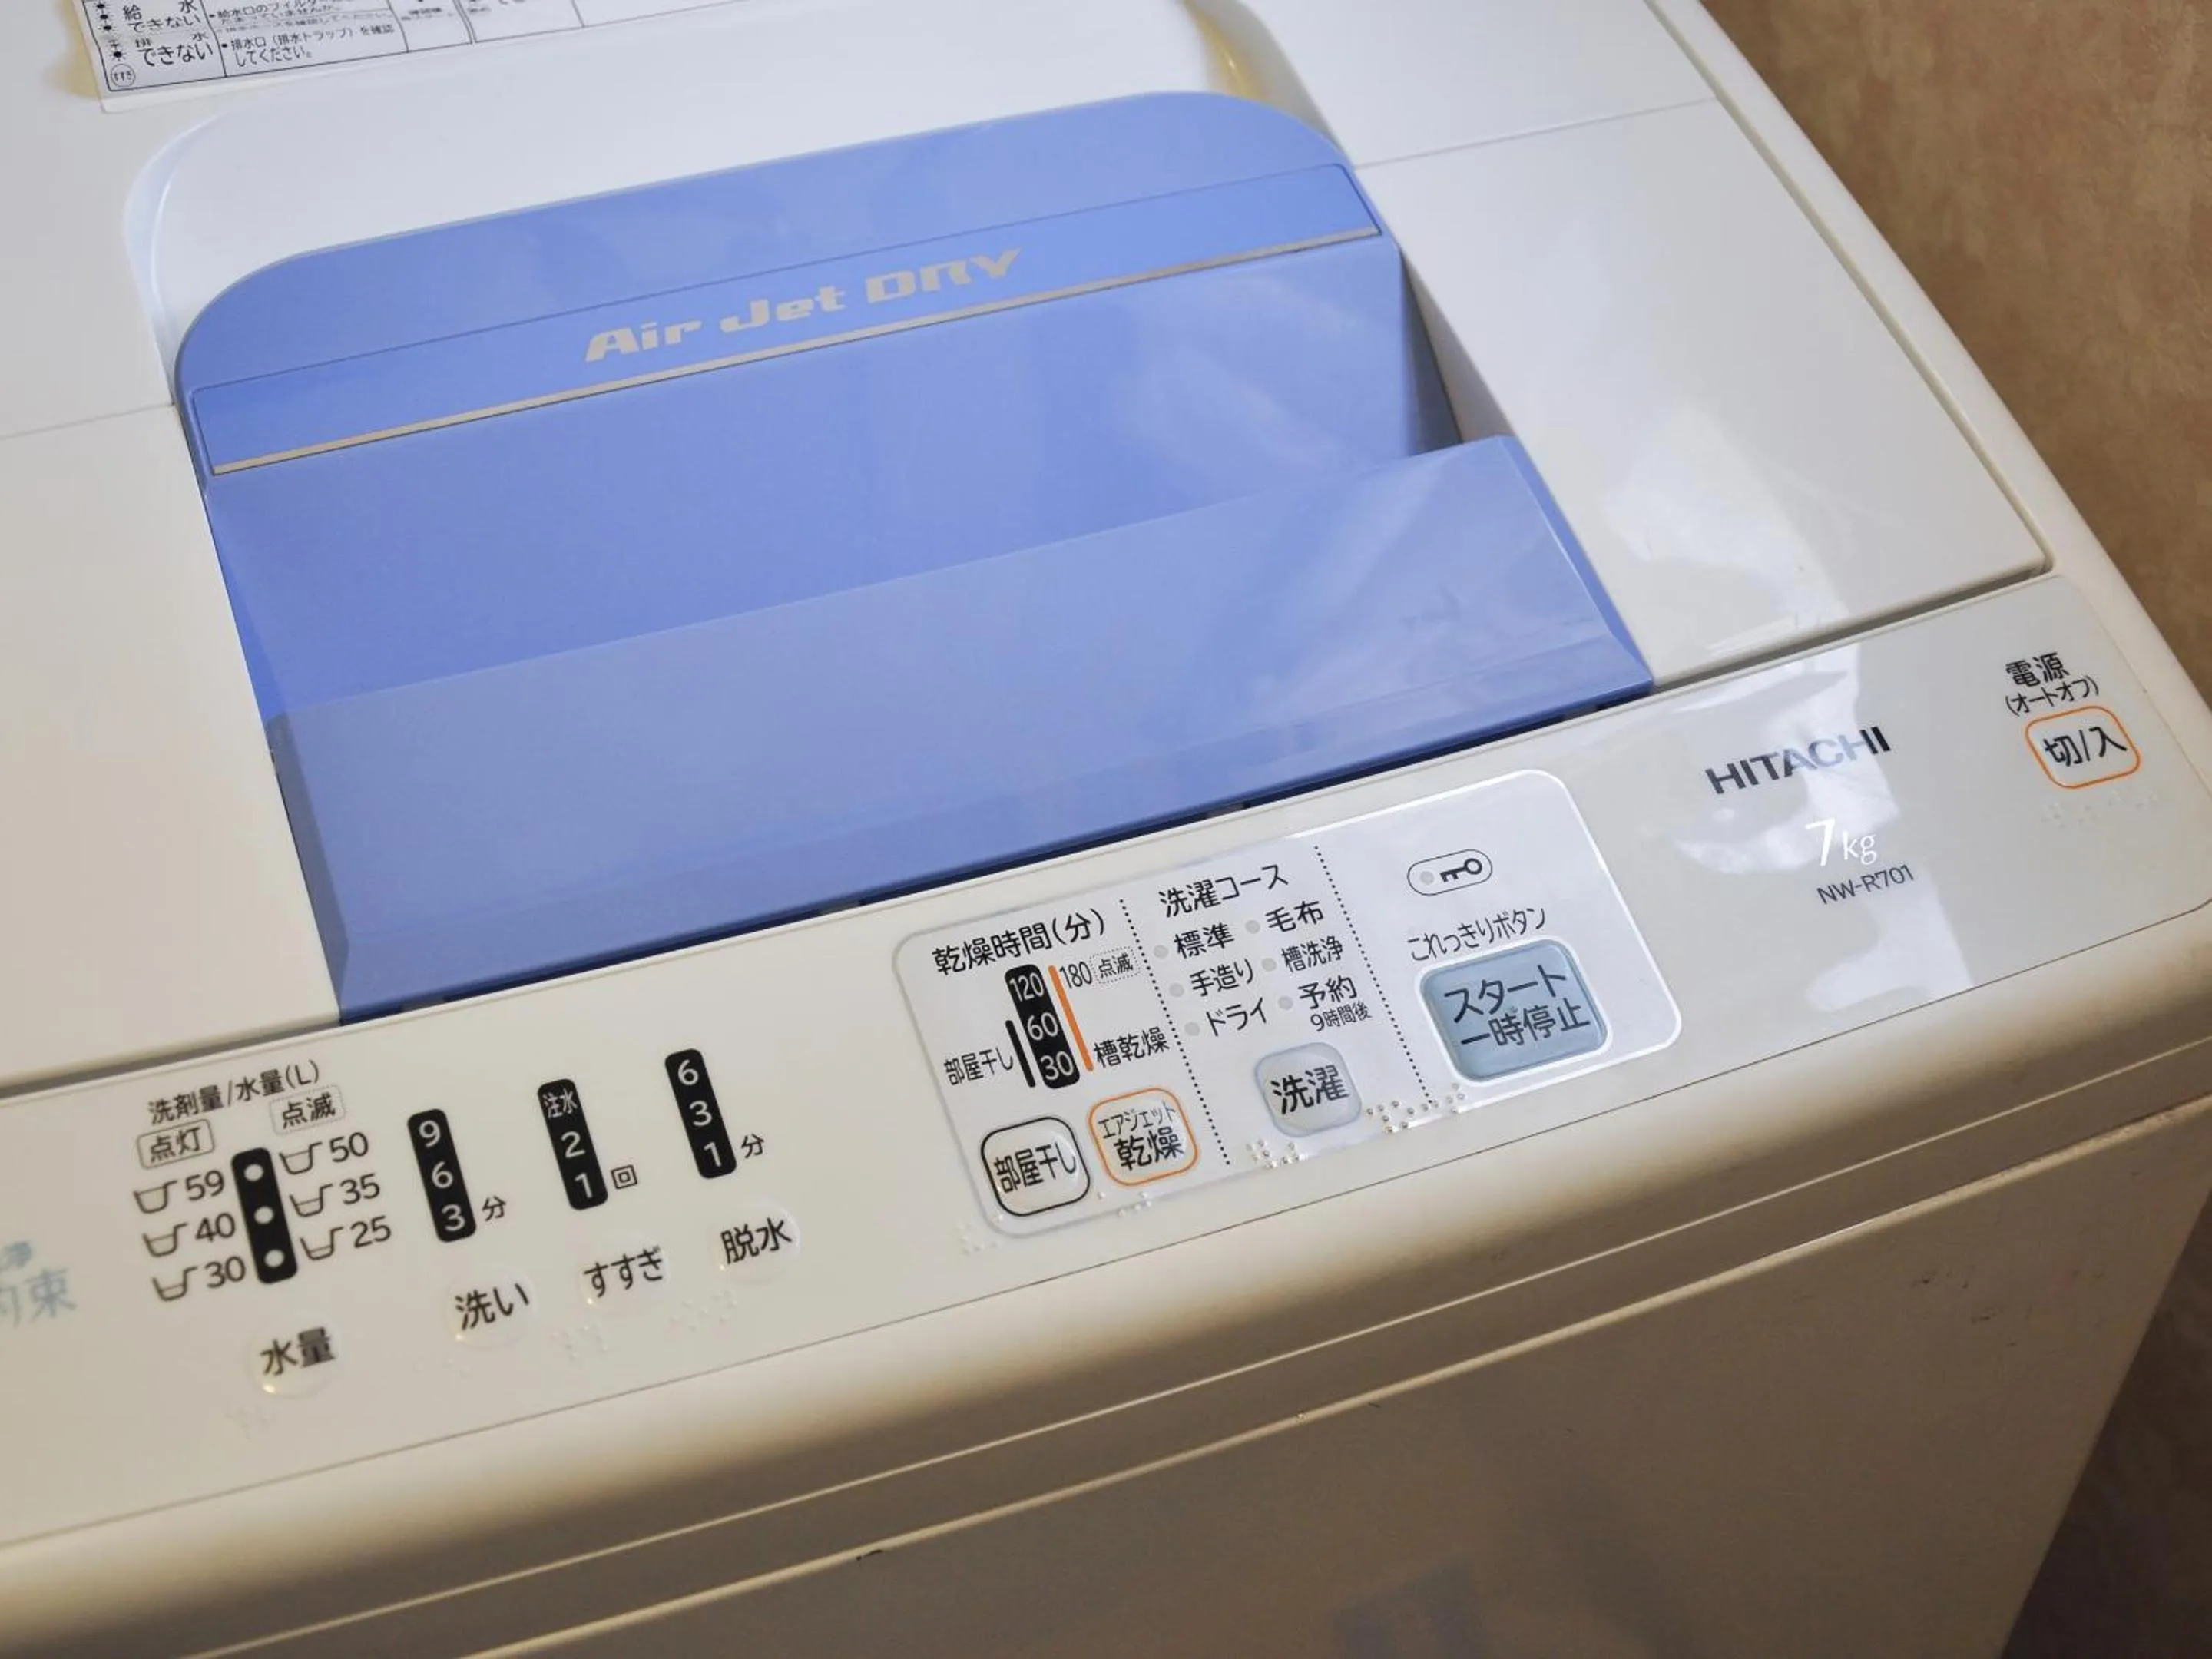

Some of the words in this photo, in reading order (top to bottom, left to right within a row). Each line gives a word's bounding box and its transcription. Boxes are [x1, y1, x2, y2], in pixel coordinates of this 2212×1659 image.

[137, 43, 214, 67] できない
[584, 320, 702, 362] Air
[720, 285, 846, 333] Jet
[865, 248, 1022, 304] DRY
[2005, 652, 2070, 687] 電源
[2005, 675, 2099, 717] (オートオフ)
[1705, 726, 1892, 795] HITACHI
[2043, 726, 2128, 767] 切/入
[1158, 864, 1289, 918] 洗濯コース
[1816, 864, 1915, 905] NW-R701
[1265, 900, 1325, 933] 毛布
[1407, 907, 1545, 961] これっきりボタン
[932, 908, 1105, 975] 乾燥時間(分)
[1174, 922, 1235, 959] 標準
[1281, 935, 1344, 973] 槽洗浄
[1009, 972, 1045, 1002] 120
[1059, 960, 1093, 989] 180
[1098, 953, 1133, 979] 点滅
[1190, 959, 1255, 998] 手造り
[1298, 975, 1358, 1010] 予約
[1444, 965, 1567, 1024] スタート
[1027, 1012, 1058, 1041] 60
[1206, 997, 1267, 1037] ドライ
[1310, 1001, 1373, 1031] 9時間後
[1460, 998, 1591, 1046] 一時停止
[944, 1046, 1015, 1086] 部屋干し
[1039, 1050, 1074, 1081] 30
[1094, 1027, 1171, 1069] 槽乾燥
[677, 1058, 699, 1087] 6
[1270, 1065, 1349, 1115] 洗濯
[281, 1092, 337, 1129] 点滅
[542, 1088, 578, 1118] 注水
[688, 1100, 713, 1127] 3
[1098, 1101, 1177, 1140] エアジェット
[149, 1127, 202, 1162] 点灯
[329, 1131, 369, 1163] 50
[419, 1120, 441, 1148] 9
[561, 1131, 586, 1158] 2
[704, 1141, 723, 1167] 1
[741, 1133, 765, 1159] 分
[1114, 1127, 1184, 1171] 乾燥
[184, 1170, 225, 1202] 59
[431, 1162, 454, 1190] 6
[574, 1172, 593, 1198] 1
[611, 1164, 637, 1189] 回
[993, 1142, 1077, 1194] 部屋干し
[339, 1174, 381, 1204] 35
[194, 1212, 236, 1243] 40
[352, 1215, 392, 1248] 25
[441, 1204, 466, 1232] 3
[482, 1196, 507, 1222] 分
[720, 1217, 793, 1264] 脱水
[204, 1256, 247, 1289] 30
[583, 1245, 664, 1298] すすぎ
[455, 1283, 530, 1331] 洗い
[260, 1326, 336, 1377] 水量
